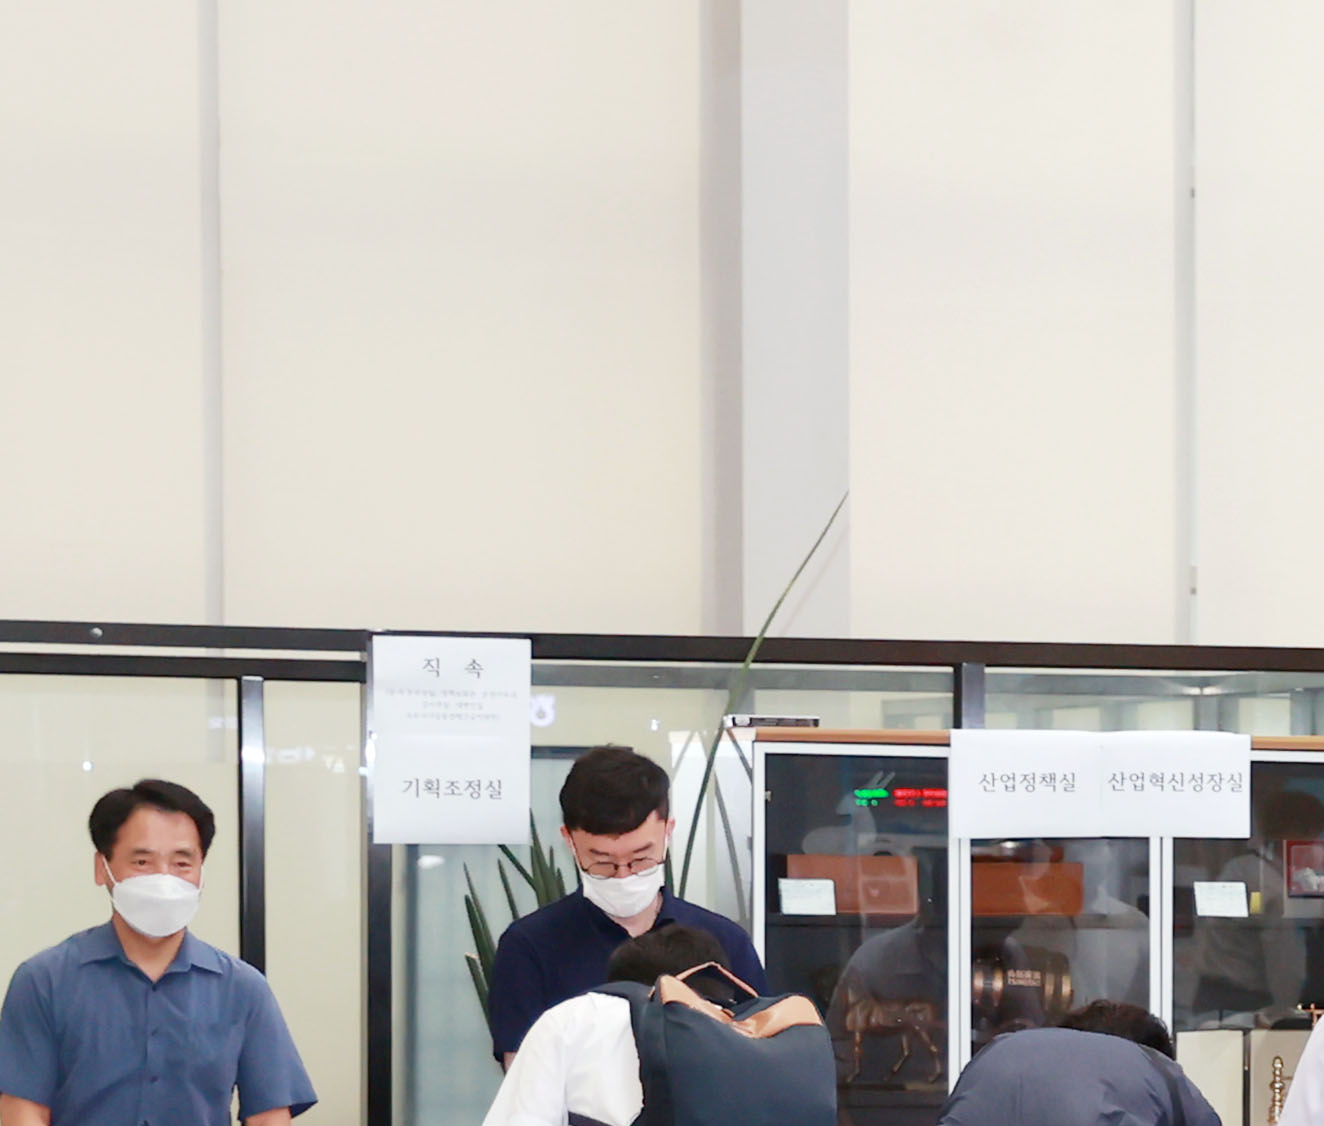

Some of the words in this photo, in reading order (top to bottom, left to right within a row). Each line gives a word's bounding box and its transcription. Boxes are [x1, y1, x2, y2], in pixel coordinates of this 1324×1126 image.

[422, 657, 441, 678] 직
[464, 658, 484, 679] 속
[403, 778, 502, 800] 기획조정실
[979, 772, 1076, 793] 산업정책실
[1108, 771, 1243, 793] 산업혁신성장실
